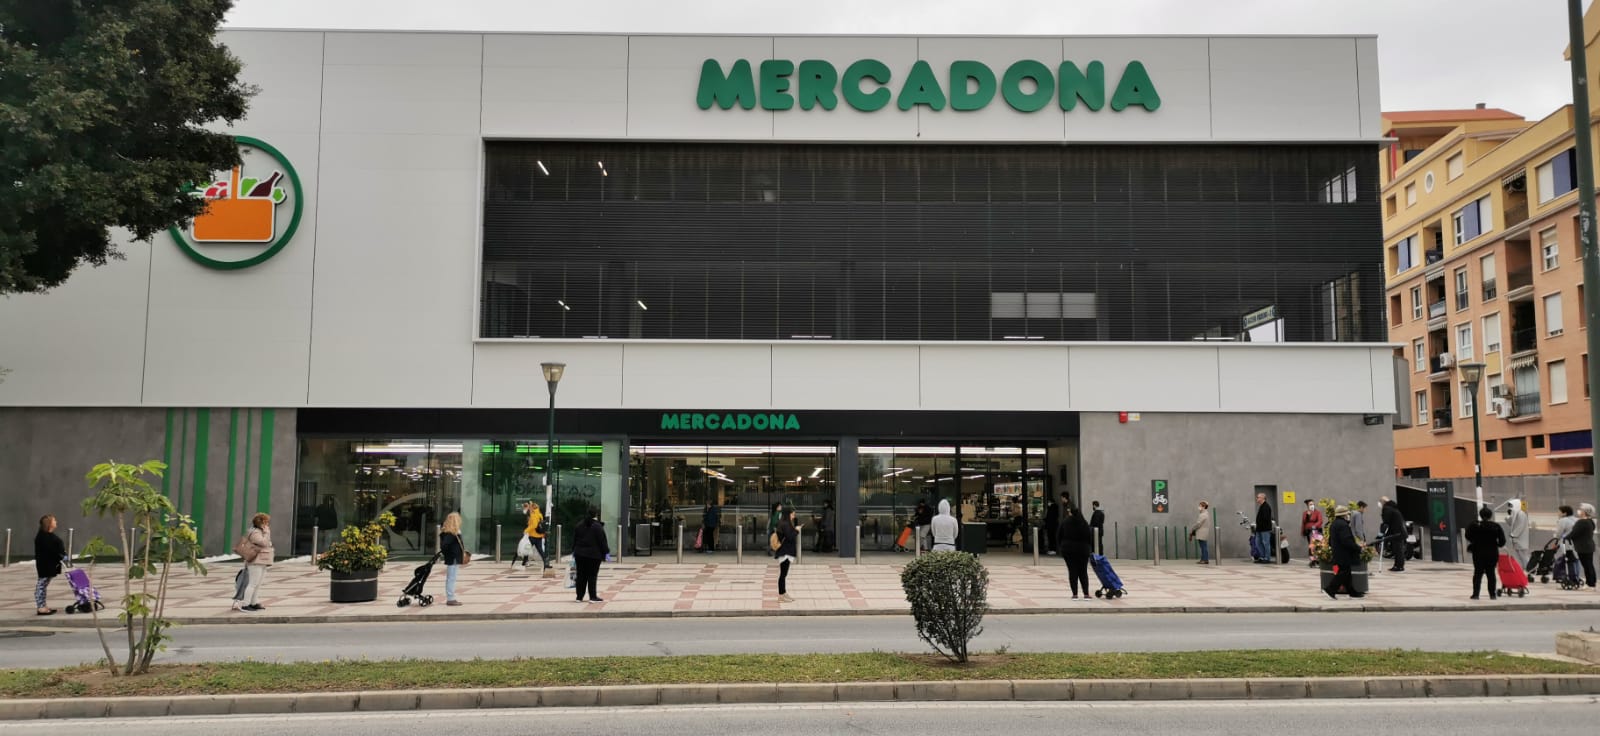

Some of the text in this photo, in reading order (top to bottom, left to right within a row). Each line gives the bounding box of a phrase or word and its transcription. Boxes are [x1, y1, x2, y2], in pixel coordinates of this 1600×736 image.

[696, 58, 1161, 112] MERCADONA
[661, 413, 800, 430] MERCADONA
[1155, 480, 1166, 493] P
[1432, 501, 1445, 524] P
